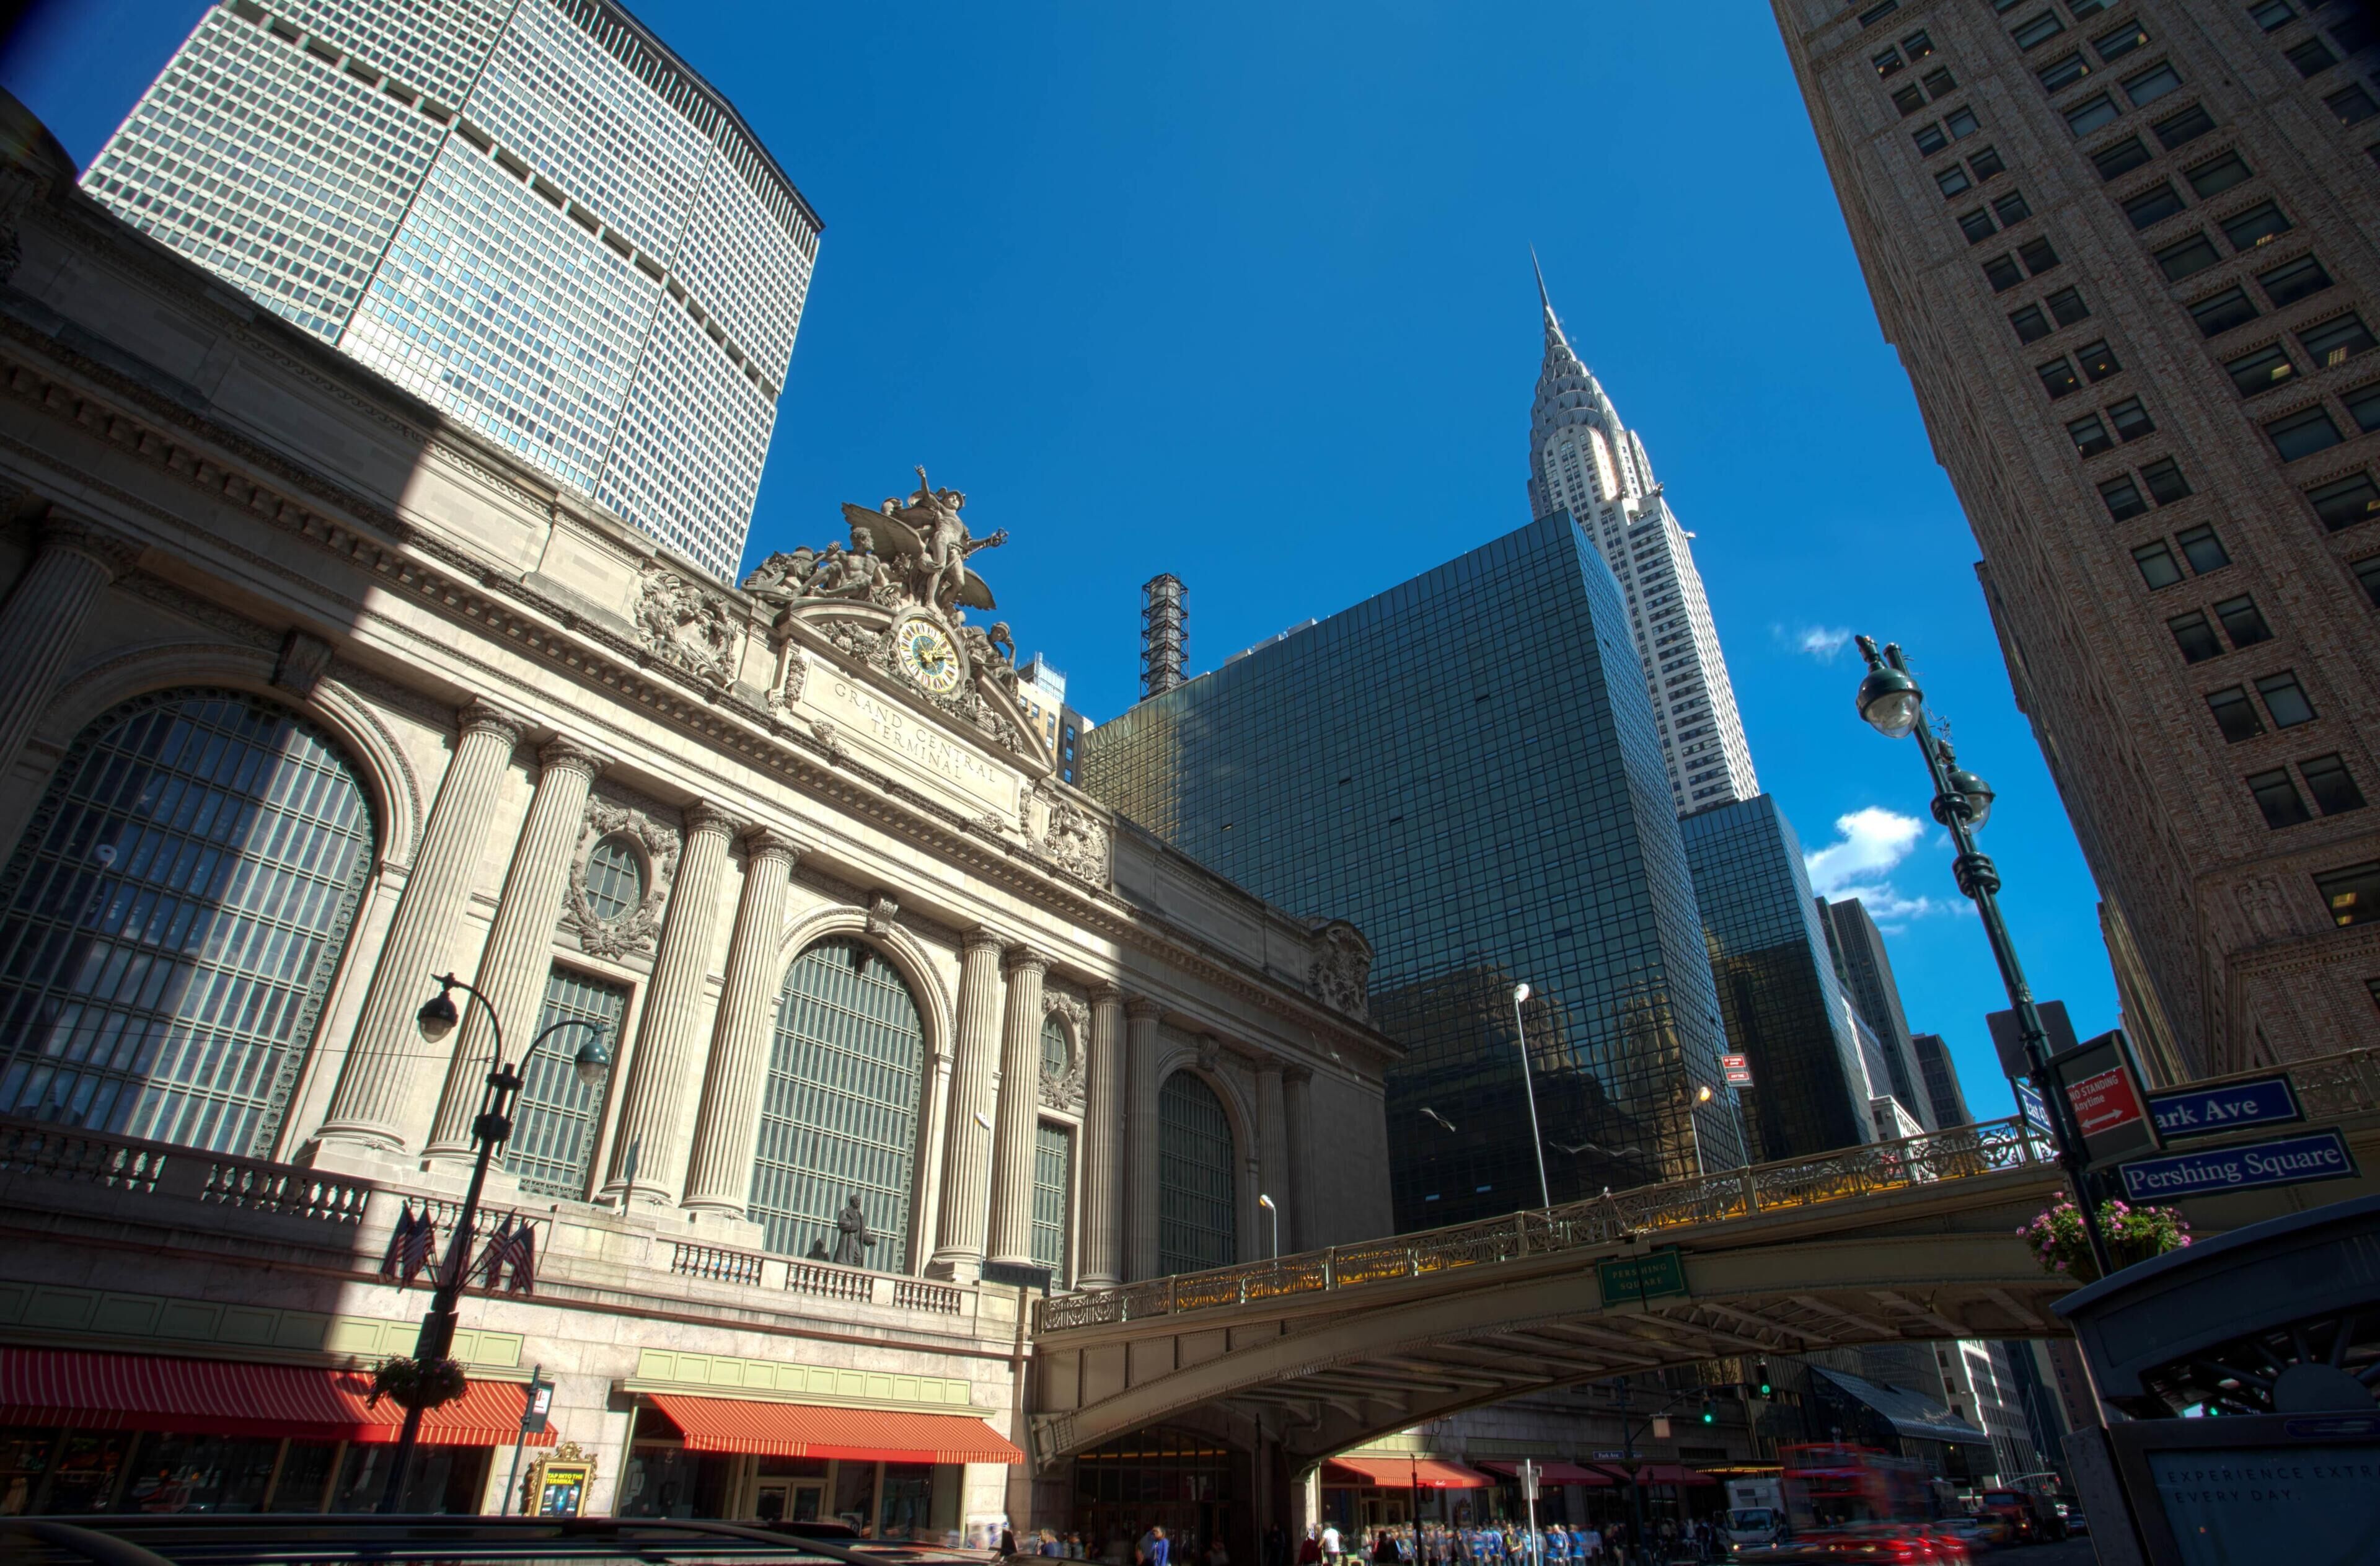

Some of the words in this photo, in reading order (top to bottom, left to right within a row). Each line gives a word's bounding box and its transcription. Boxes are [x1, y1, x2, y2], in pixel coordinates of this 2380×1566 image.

[835, 683, 902, 728] GRAND
[916, 729, 995, 782] CENTRAL
[871, 718, 962, 779] TERMINAL
[2069, 1090, 2081, 1101] NO
[2081, 1075, 2118, 1096] STANDING
[2022, 1094, 2042, 1121] East
[2074, 1095, 2105, 1112] Anytime
[2155, 1104, 2199, 1128] ark
[2205, 1099, 2259, 1121] Ave
[2126, 1161, 2243, 1192] Pershing
[2244, 1148, 2341, 1176] Square
[1613, 1263, 1667, 1279] PERSHING
[1621, 1277, 1664, 1290] SQUARE
[2167, 1467, 2303, 1484] EXPERIENCE
[2314, 1464, 2380, 1479] EXTR
[2174, 1490, 2239, 1503] EVERY
[2250, 1489, 2301, 1502] DAY.
